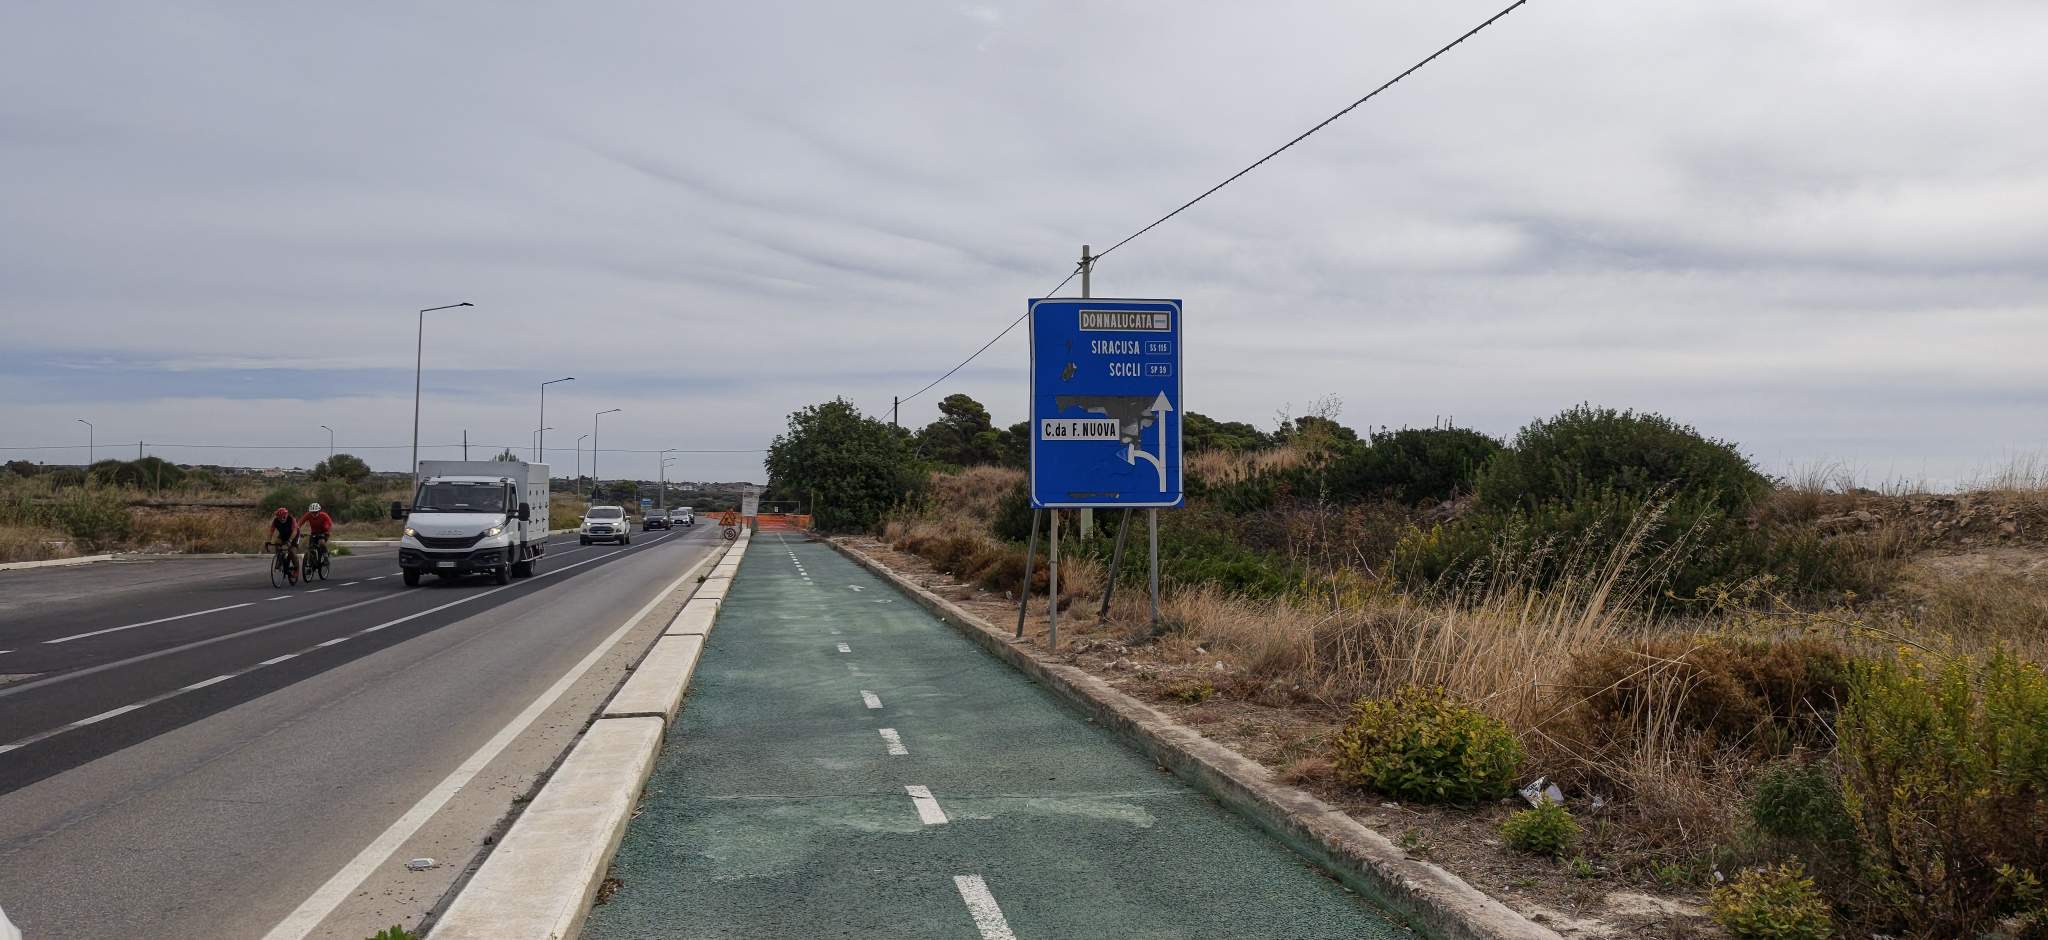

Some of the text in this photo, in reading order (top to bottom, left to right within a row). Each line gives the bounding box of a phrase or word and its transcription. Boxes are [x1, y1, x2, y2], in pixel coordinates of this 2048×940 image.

[1082, 313, 1152, 328] DONNALUCATA
[1091, 340, 1140, 354] SIRACUSA
[1109, 362, 1140, 377] SCICLI
[1150, 365, 1157, 374] SP
[1045, 422, 1067, 437] C.da
